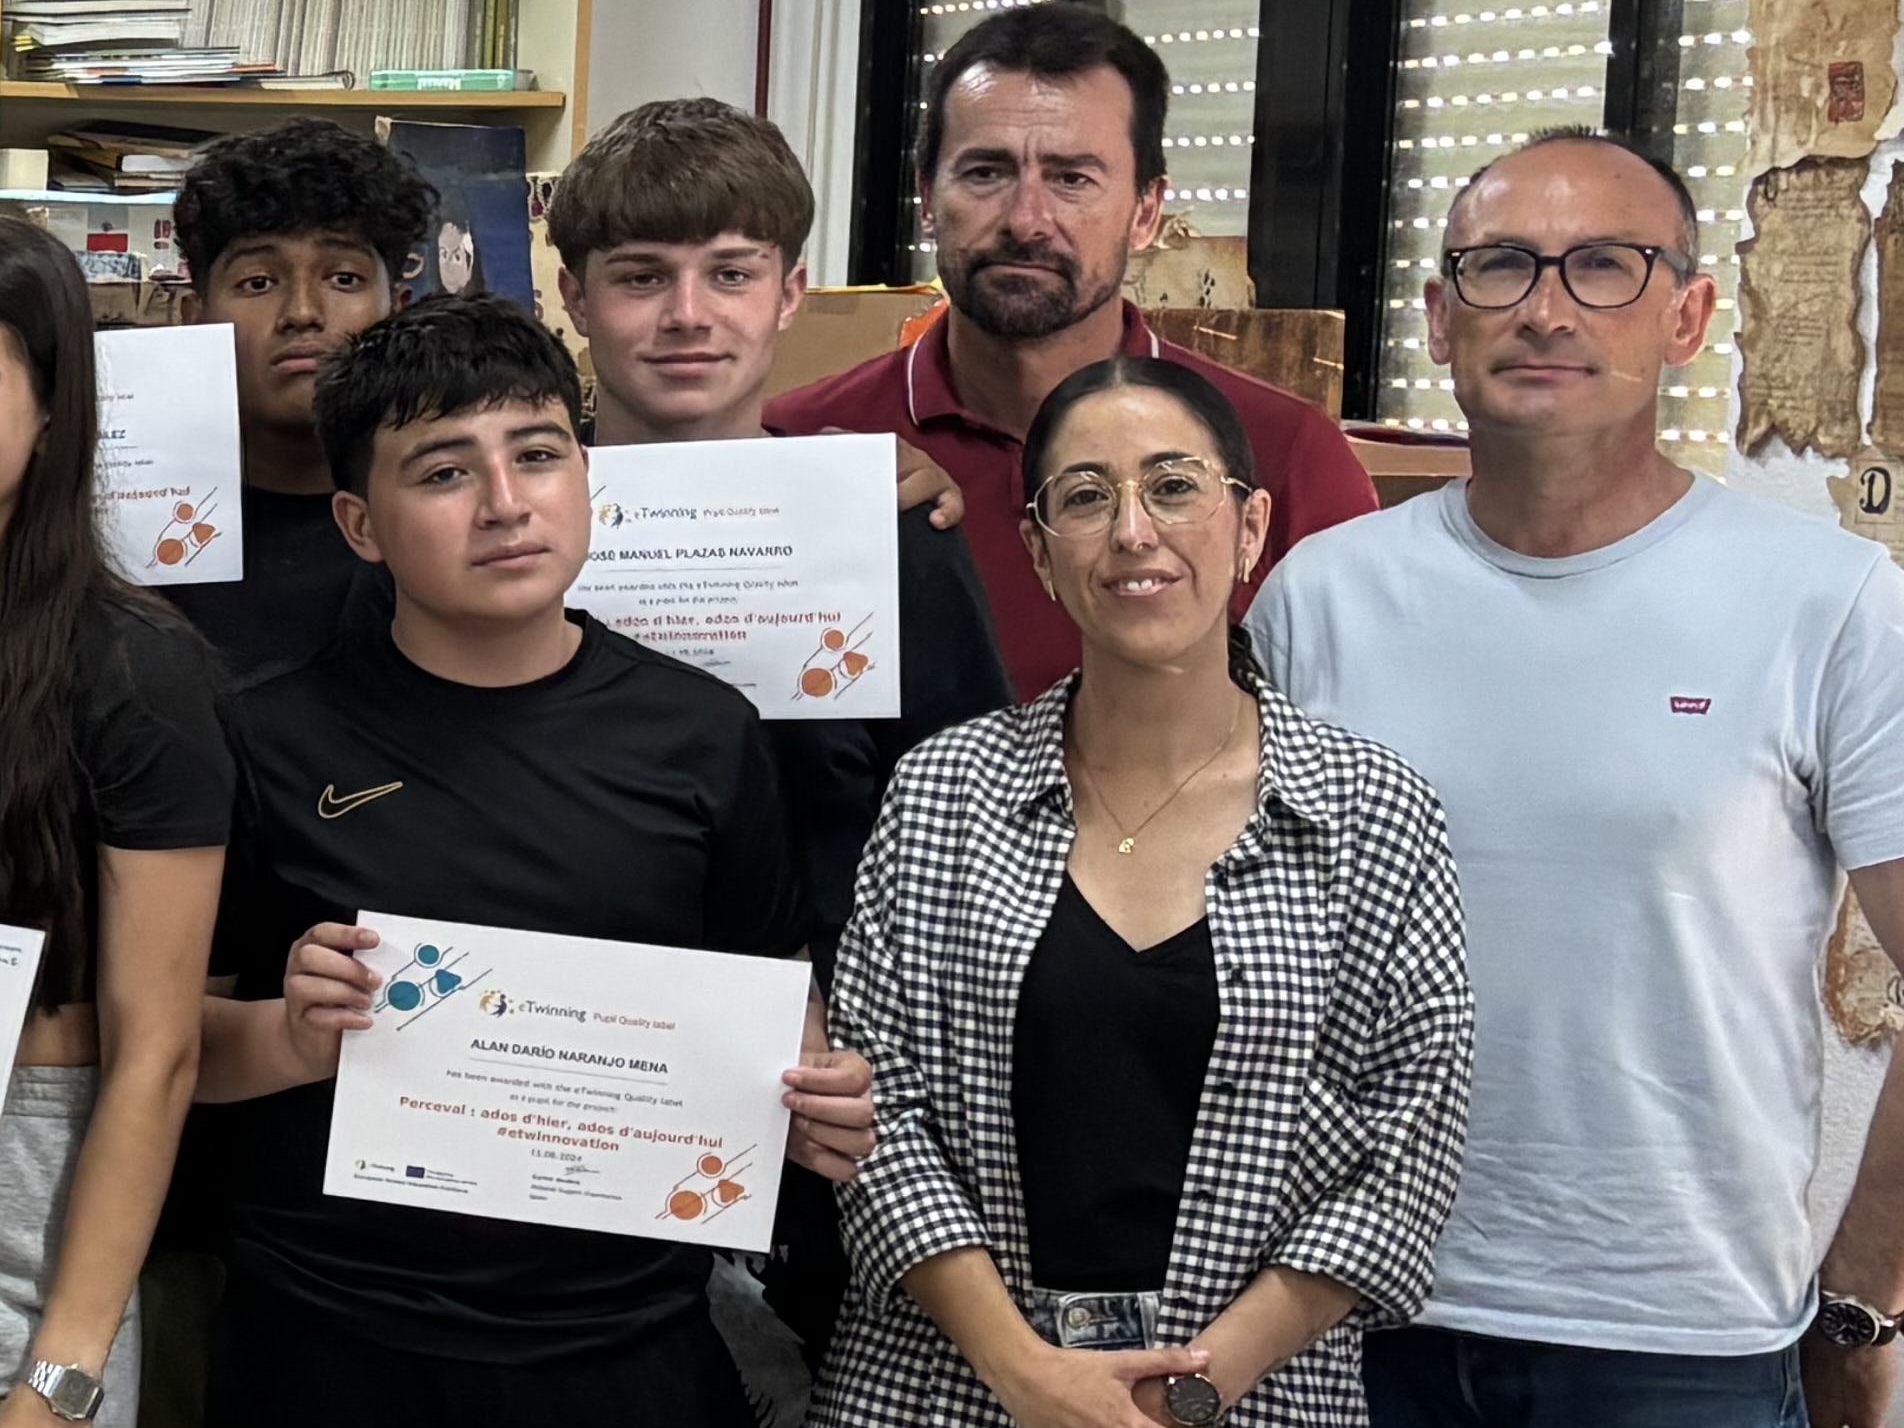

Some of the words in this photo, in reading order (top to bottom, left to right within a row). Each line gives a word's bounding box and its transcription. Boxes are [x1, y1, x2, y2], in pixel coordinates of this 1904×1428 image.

[1859, 466, 1892, 516] D
[619, 548, 672, 560] MANUEL
[518, 999, 586, 1023] eTwinning
[592, 1012, 617, 1023] Pupil
[618, 1015, 650, 1029] Quality
[470, 1038, 509, 1052] ALAN
[511, 1043, 555, 1059] DARÍO
[558, 1049, 625, 1068] NARANJO
[628, 1058, 668, 1074] MENA
[399, 1096, 466, 1114] Perceval
[480, 1108, 517, 1122] ados
[522, 1113, 571, 1130] d'hier,
[576, 1121, 614, 1135] ados
[618, 1125, 722, 1148] d'aujourd'hui
[496, 1126, 619, 1151] #etwinnovation
